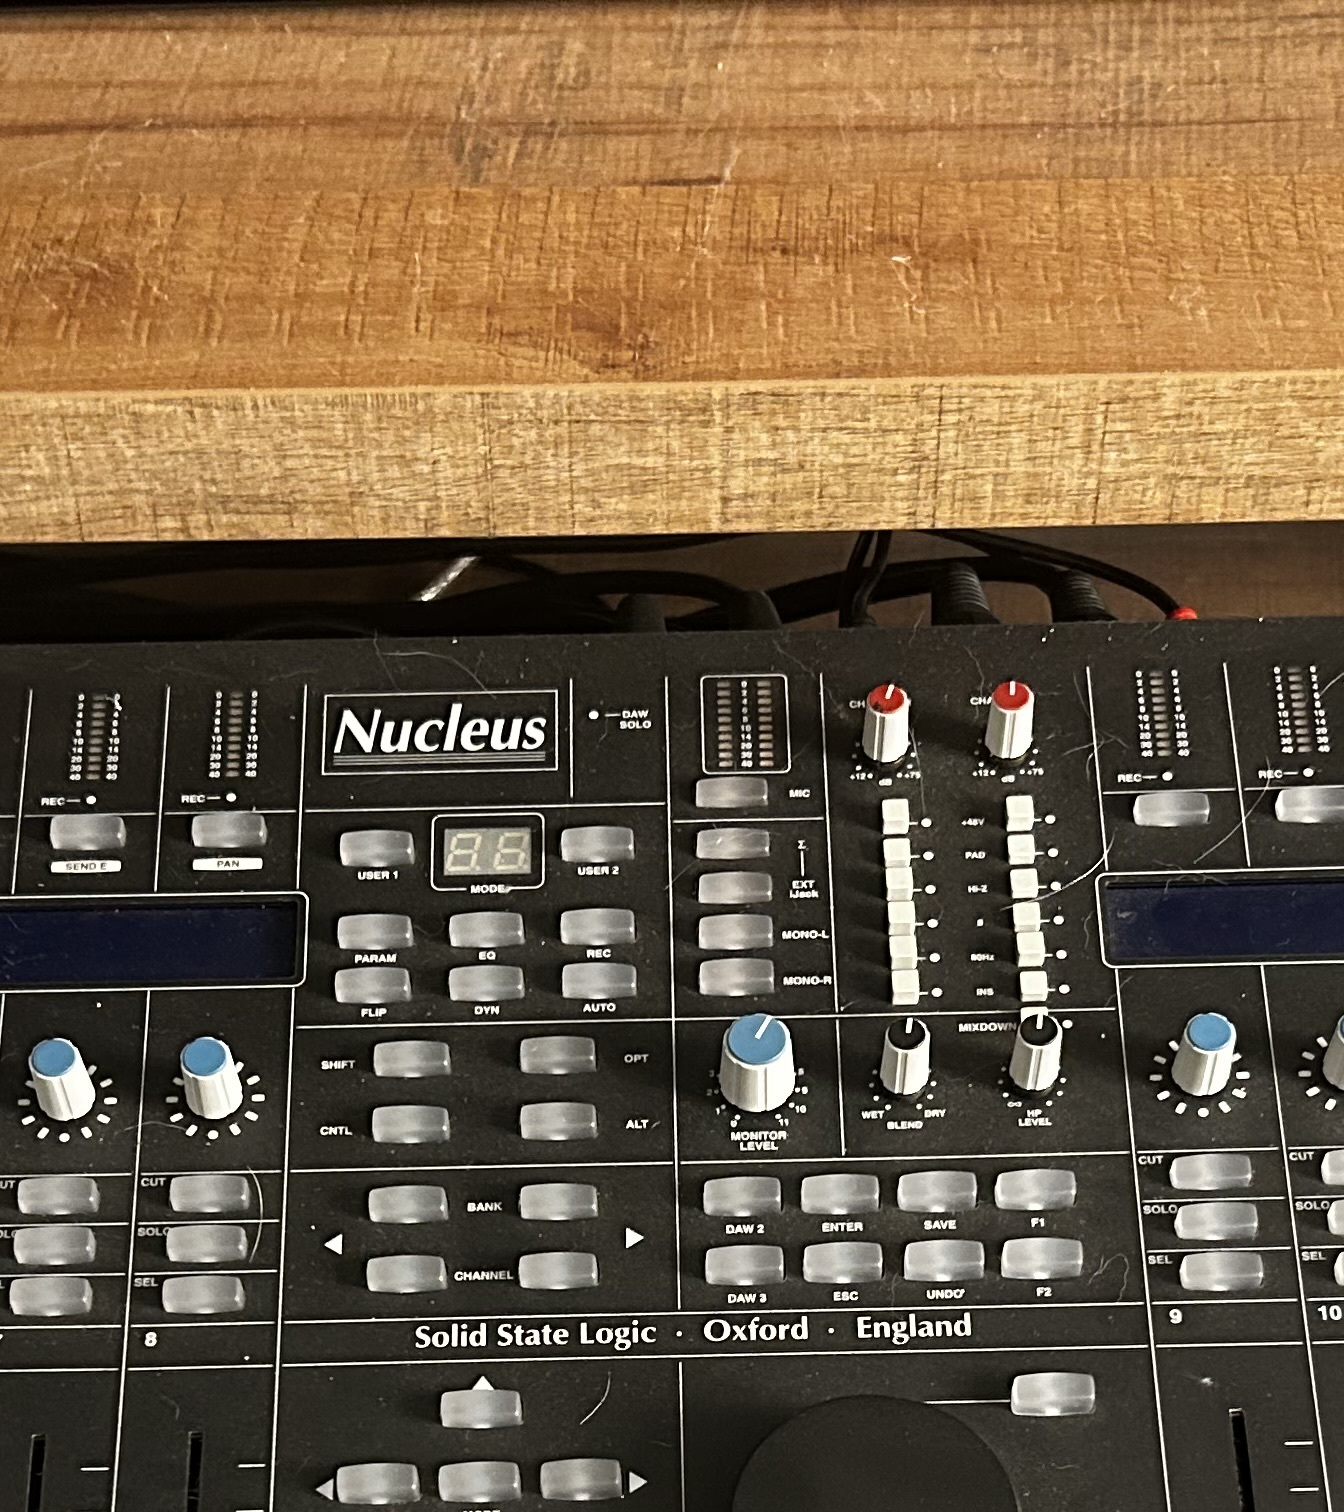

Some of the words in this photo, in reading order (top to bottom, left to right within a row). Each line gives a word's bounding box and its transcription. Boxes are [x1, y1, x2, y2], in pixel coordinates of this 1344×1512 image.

[622, 710, 648, 719] DAW
[333, 703, 546, 753] Nucleus
[619, 721, 652, 729] SOLO
[1118, 774, 1142, 783] REC
[1258, 769, 1282, 779] REC
[789, 789, 810, 798] MIC
[41, 797, 65, 806] REC
[181, 794, 205, 803] REC
[965, 851, 986, 859] PAD
[357, 871, 390, 880] USER
[393, 871, 398, 879] 1
[577, 866, 608, 876] USER
[612, 866, 619, 875] 2
[471, 884, 505, 894] MODE
[792, 880, 815, 889] EXT
[782, 930, 829, 939] MONO-L
[478, 951, 496, 961] EQ
[587, 949, 611, 958] REC
[355, 954, 396, 963] PARAM
[783, 976, 832, 985] MONO-R
[976, 988, 994, 996] INS
[474, 1006, 500, 1015] DYN
[583, 1003, 616, 1012] AUTO
[361, 1008, 387, 1017] FLIP
[959, 1022, 1017, 1032] MIXDOWN
[624, 1054, 649, 1063] OPT
[321, 1060, 356, 1069] SHIFT
[862, 1110, 884, 1119] WET
[925, 1108, 946, 1117] DRY
[1027, 1109, 1042, 1118] HP
[626, 1120, 649, 1129] ALT
[887, 1121, 923, 1130] BLEND
[1018, 1117, 1052, 1126] LEVEL
[320, 1126, 352, 1135] CNTL
[731, 1131, 787, 1141] MONITOR
[740, 1141, 778, 1151] LEVEL
[1139, 1155, 1163, 1165] CUT
[1289, 1151, 1313, 1162] CUT
[141, 1177, 166, 1187] CUT
[467, 1202, 502, 1211] BANK
[1143, 1204, 1178, 1215] SOLO
[1296, 1200, 1330, 1211] SOLO
[822, 1222, 863, 1232] ENTER
[924, 1220, 956, 1230] SAVE
[1031, 1219, 1045, 1227] F1
[726, 1225, 753, 1234] DAW
[755, 1224, 764, 1233] 2
[1148, 1255, 1172, 1265] SEL
[1302, 1251, 1326, 1261] SEL
[454, 1270, 514, 1281] CHANNEL
[134, 1277, 158, 1287] SEL
[833, 1291, 858, 1301] ESC
[926, 1289, 963, 1299] UNDO
[1036, 1288, 1052, 1297] F2
[727, 1294, 756, 1303] DAW
[758, 1293, 767, 1302] 3
[1169, 1309, 1183, 1324] 9
[1318, 1305, 1343, 1321] 10
[415, 1323, 487, 1348] Solid
[497, 1322, 569, 1347] State
[580, 1320, 656, 1350] Logic
[704, 1316, 809, 1342] Oxford
[857, 1313, 972, 1344] England
[145, 1332, 157, 1347] 8
